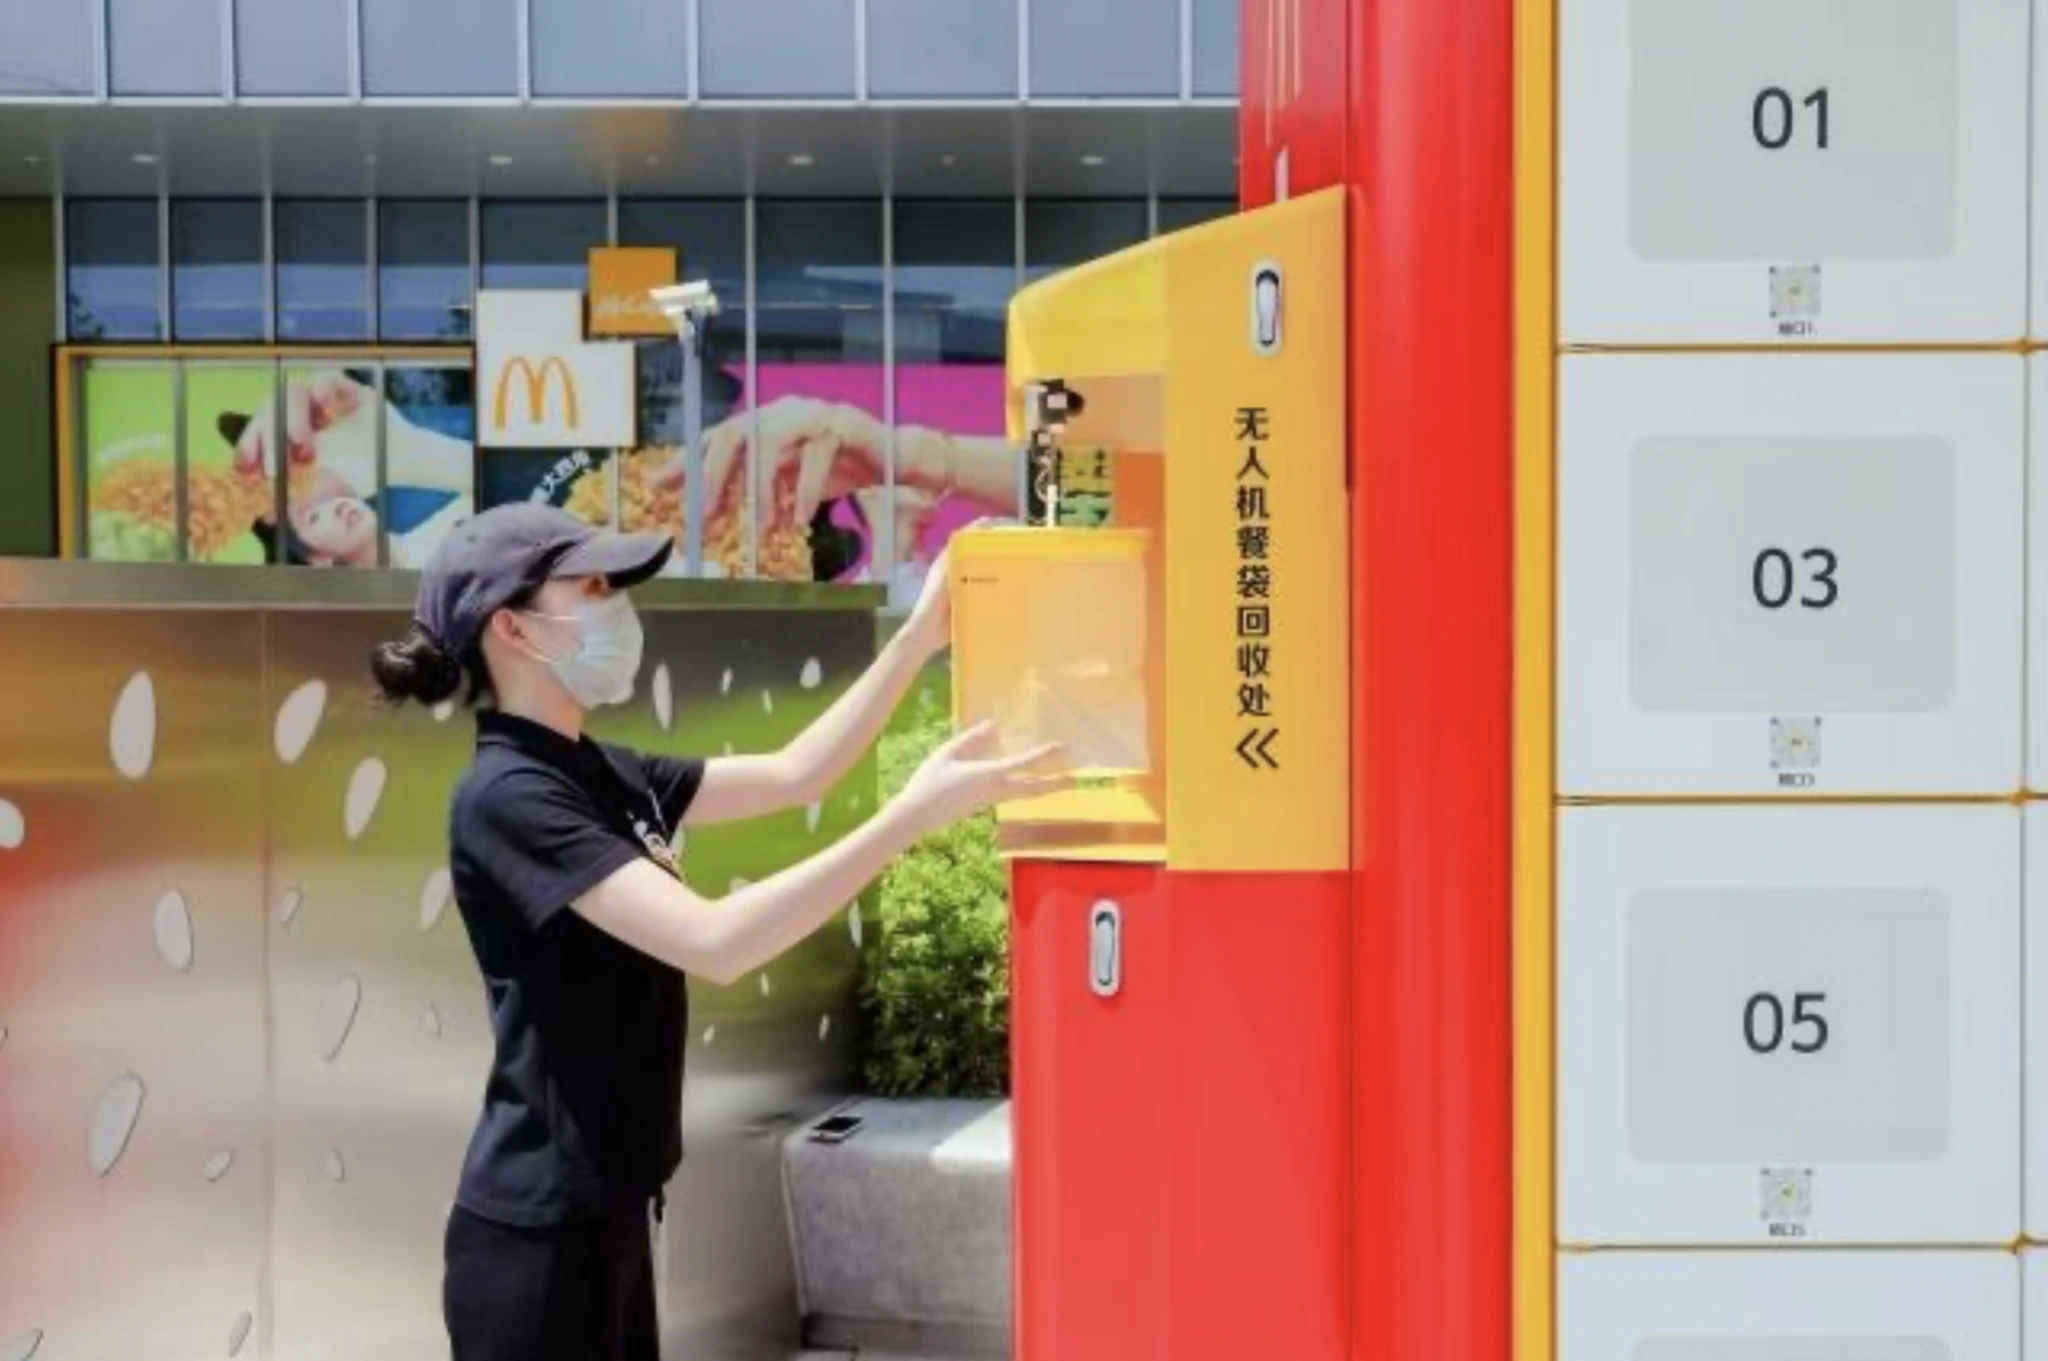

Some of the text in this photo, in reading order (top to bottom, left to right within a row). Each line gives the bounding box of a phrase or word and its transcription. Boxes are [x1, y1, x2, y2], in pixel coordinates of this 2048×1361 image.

[1751, 86, 1830, 150] 01
[494, 356, 577, 430] M
[1235, 407, 1272, 717] 无人机餐袋回收处
[1752, 547, 1839, 610] 03
[1743, 992, 1830, 1054] 05
